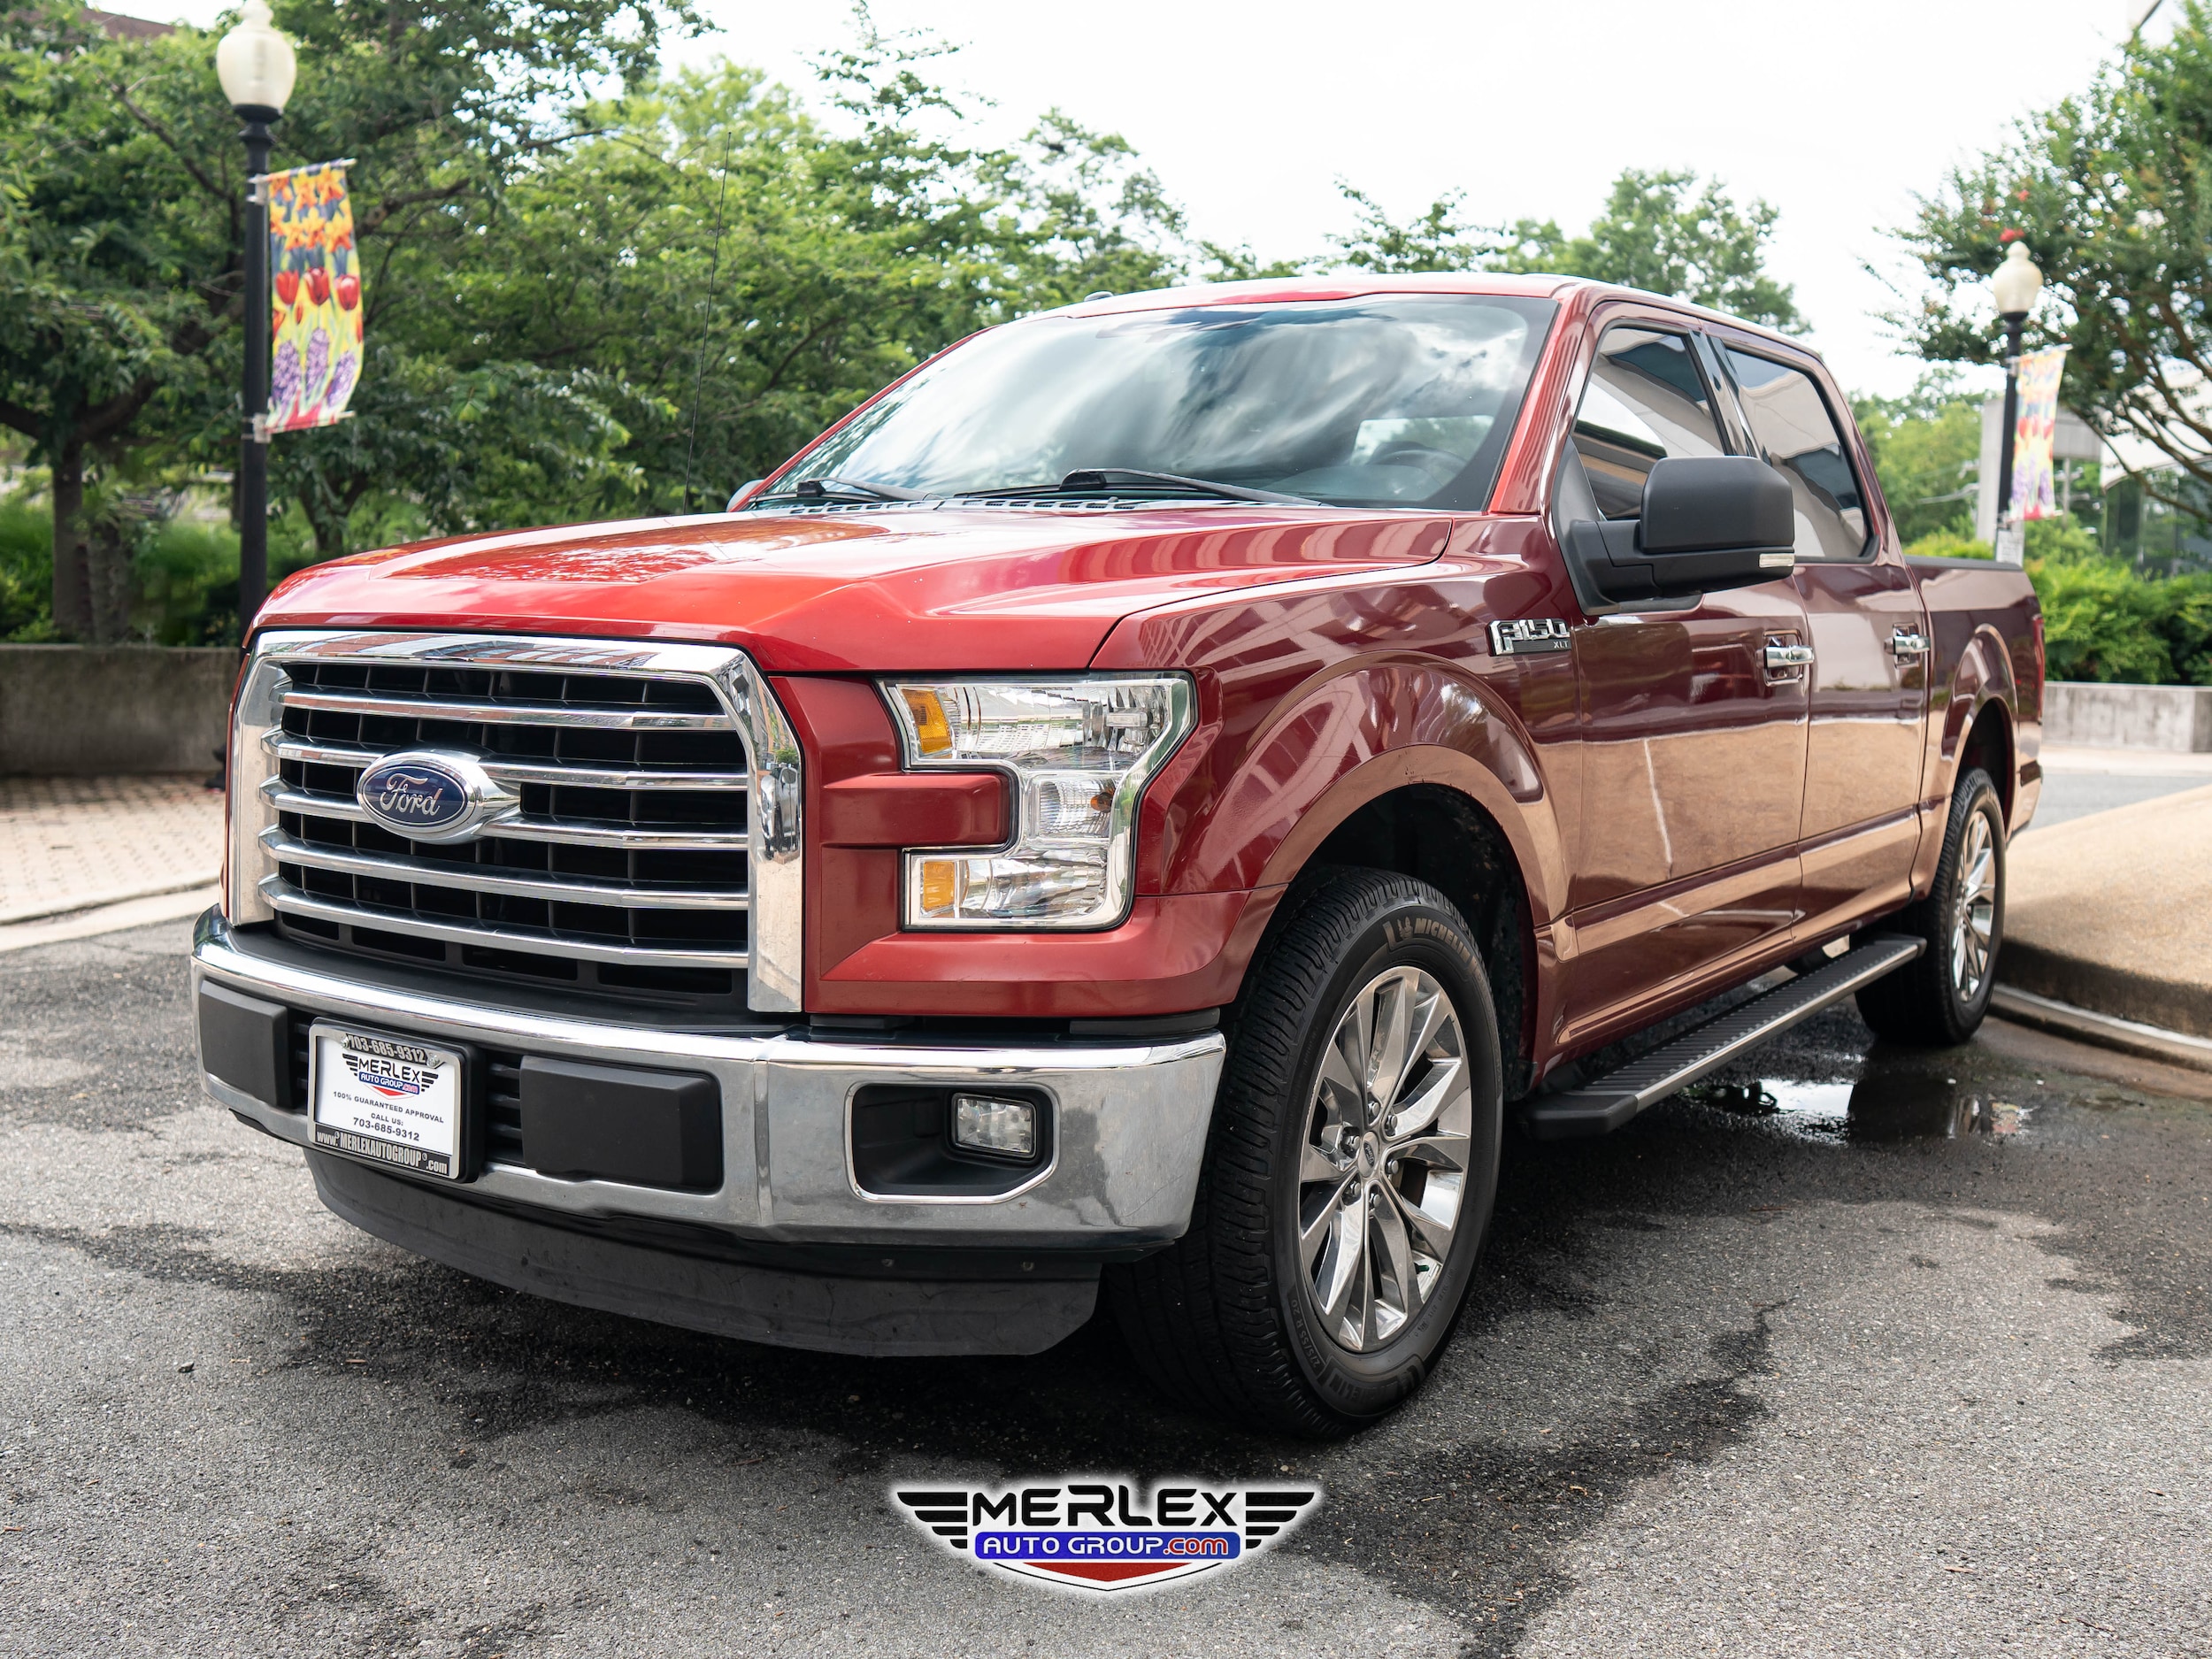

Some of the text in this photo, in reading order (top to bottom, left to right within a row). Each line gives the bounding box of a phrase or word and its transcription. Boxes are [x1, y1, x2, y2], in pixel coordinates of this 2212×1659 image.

[1553, 640, 1569, 649] XLT
[379, 772, 442, 816] Ford
[1414, 918, 1471, 964] MICHELIN
[348, 1034, 426, 1064] 703-685-9312
[358, 1057, 420, 1084] MERLEX
[360, 1073, 380, 1084] AUTO
[333, 1091, 444, 1124] 100% GUARANTEED APPROVAL
[371, 1112, 403, 1126] CALL US:
[353, 1117, 419, 1142] 703-685-9312
